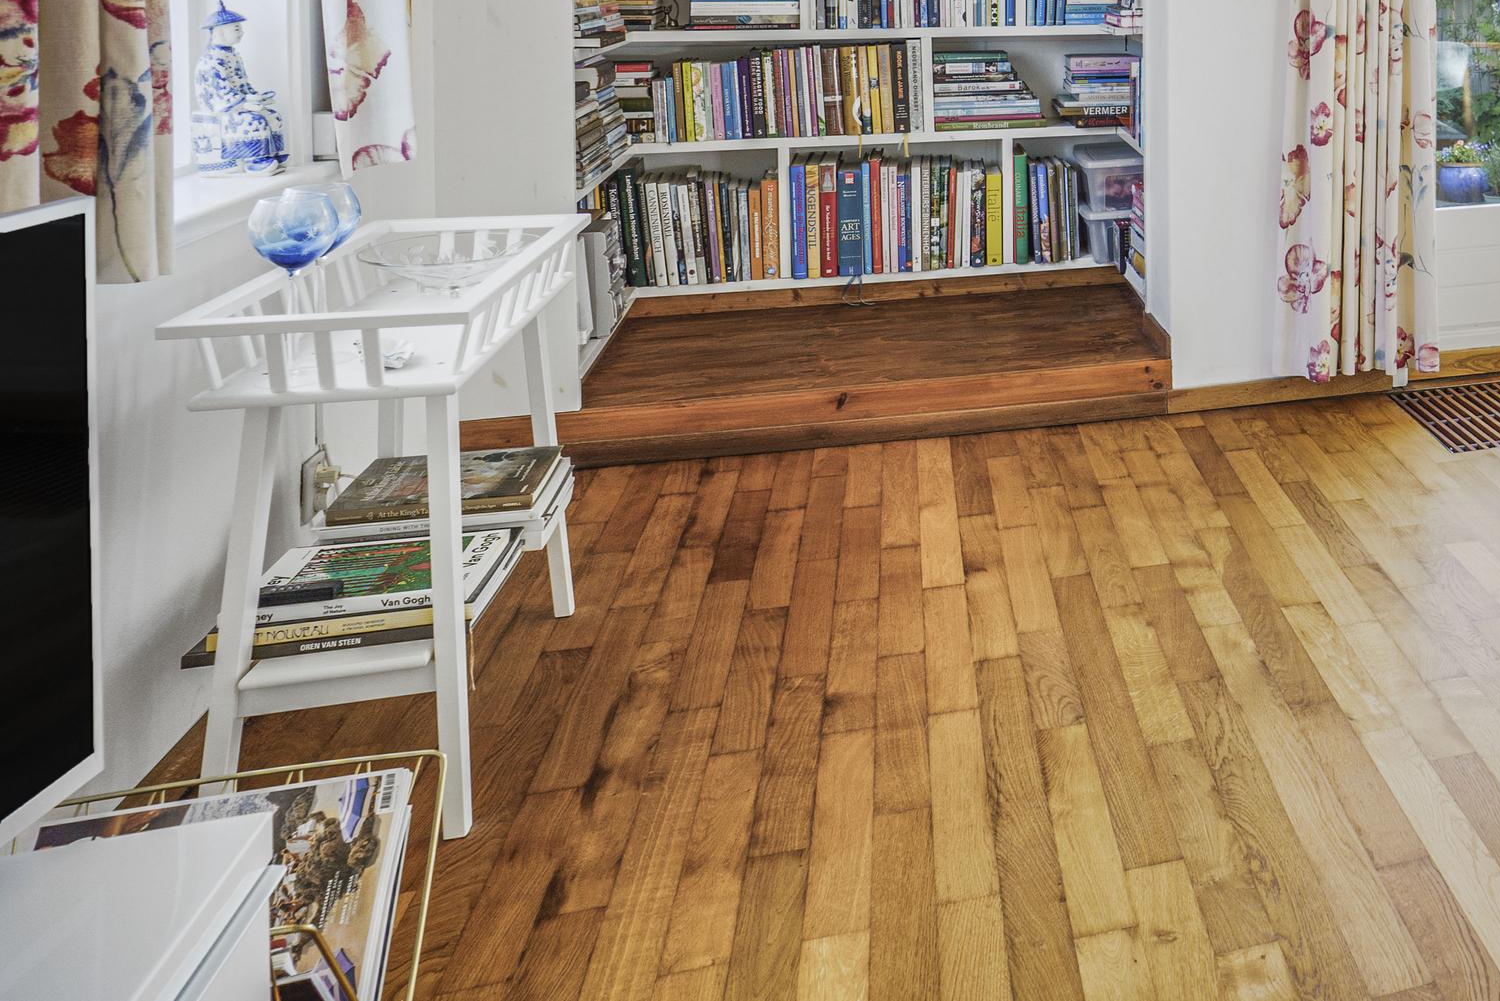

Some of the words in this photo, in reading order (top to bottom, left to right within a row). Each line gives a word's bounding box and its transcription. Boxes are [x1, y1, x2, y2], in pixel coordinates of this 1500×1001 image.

[1083, 106, 1128, 115] VERMEER
[768, 184, 774, 192] 12
[987, 188, 1000, 222] Italië
[625, 174, 635, 213] Landgoederen
[630, 220, 640, 260] Noord-Brabant
[807, 184, 816, 249] JUGENDSTIL
[841, 223, 860, 231] ART
[841, 233, 861, 241] AGES
[400, 508, 419, 518] King's
[472, 532, 502, 553] Gogh
[381, 598, 402, 607] Van
[402, 594, 431, 606] Gogh
[266, 624, 329, 642] NOUVEAU
[322, 640, 337, 649] VAN
[338, 637, 362, 647] STEEN
